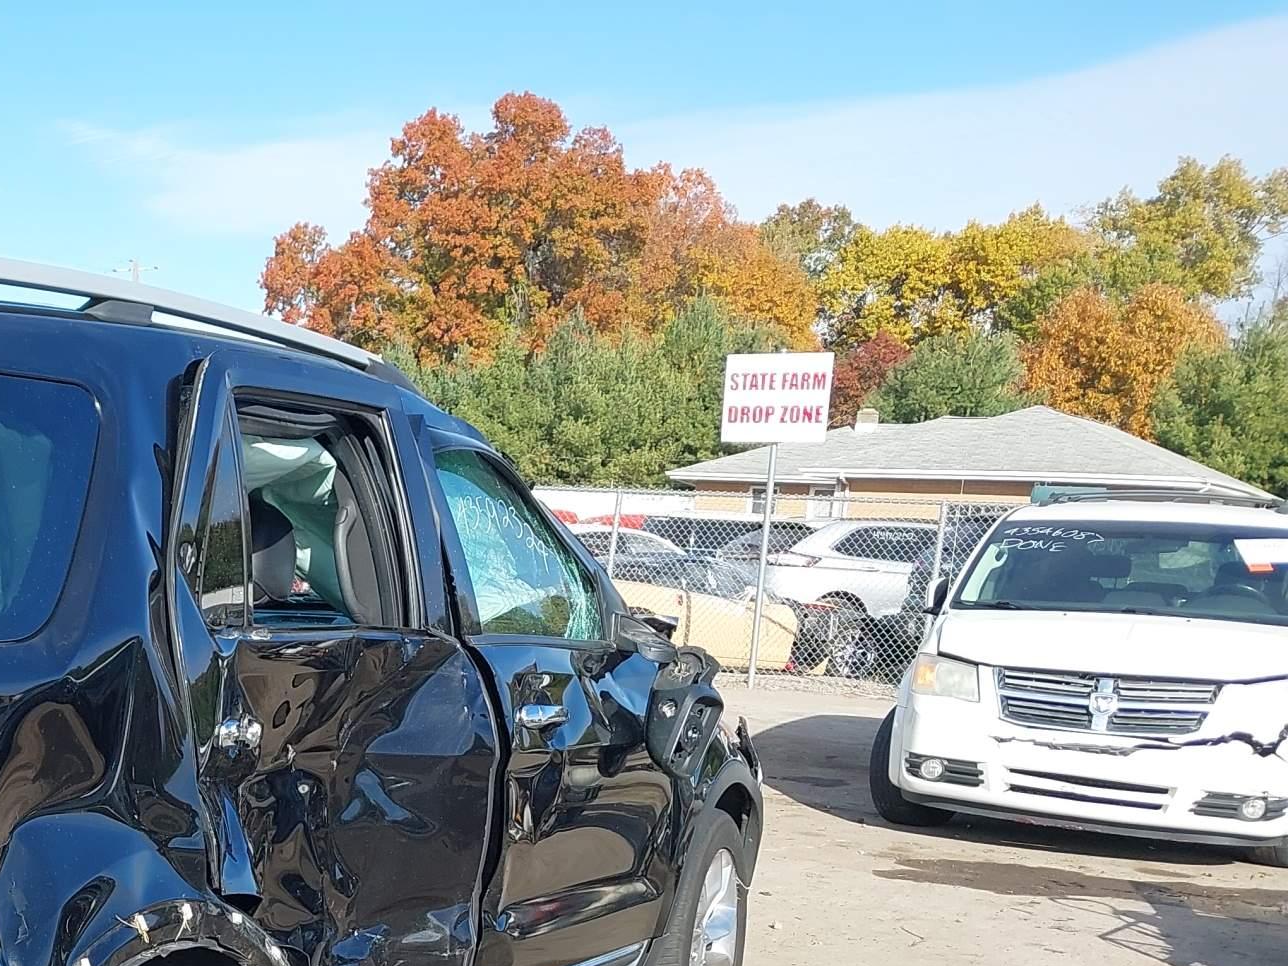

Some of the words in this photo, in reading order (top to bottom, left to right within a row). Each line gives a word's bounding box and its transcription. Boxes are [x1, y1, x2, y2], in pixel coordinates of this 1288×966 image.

[730, 372, 777, 391] STATE
[781, 372, 827, 391] FARM
[727, 405, 775, 424] DROP
[779, 405, 824, 424] ZONE
[999, 538, 1070, 552] DONE
